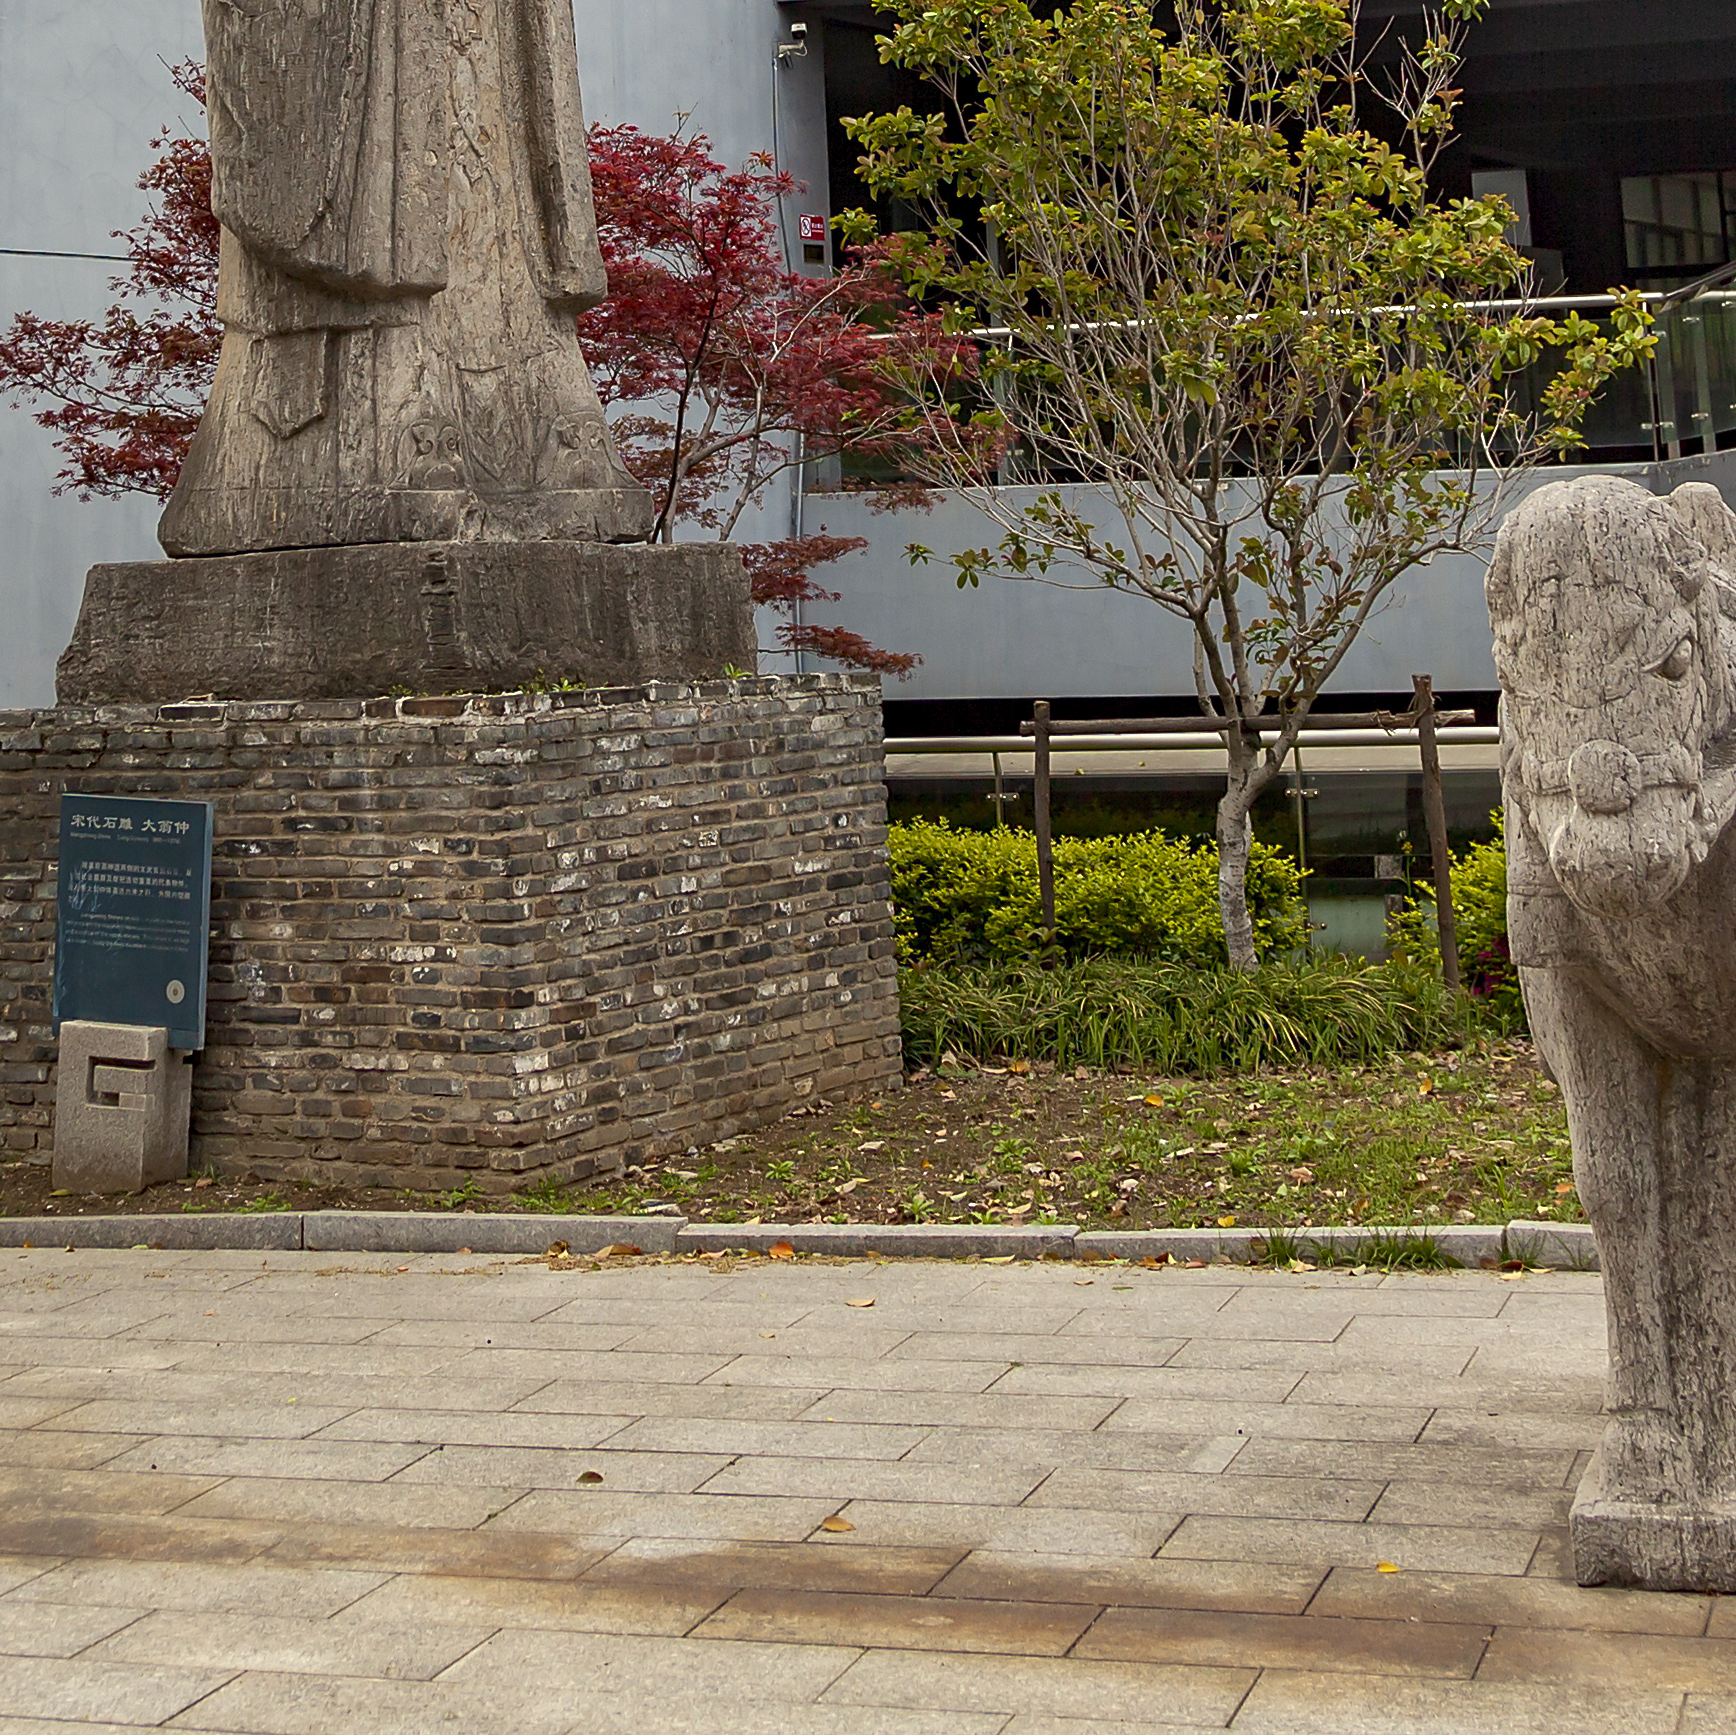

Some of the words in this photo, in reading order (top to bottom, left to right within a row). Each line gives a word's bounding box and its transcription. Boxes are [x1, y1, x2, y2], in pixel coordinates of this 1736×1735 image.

[70, 814, 133, 831] 宋代石雕
[141, 819, 190, 835] 大翁仲
